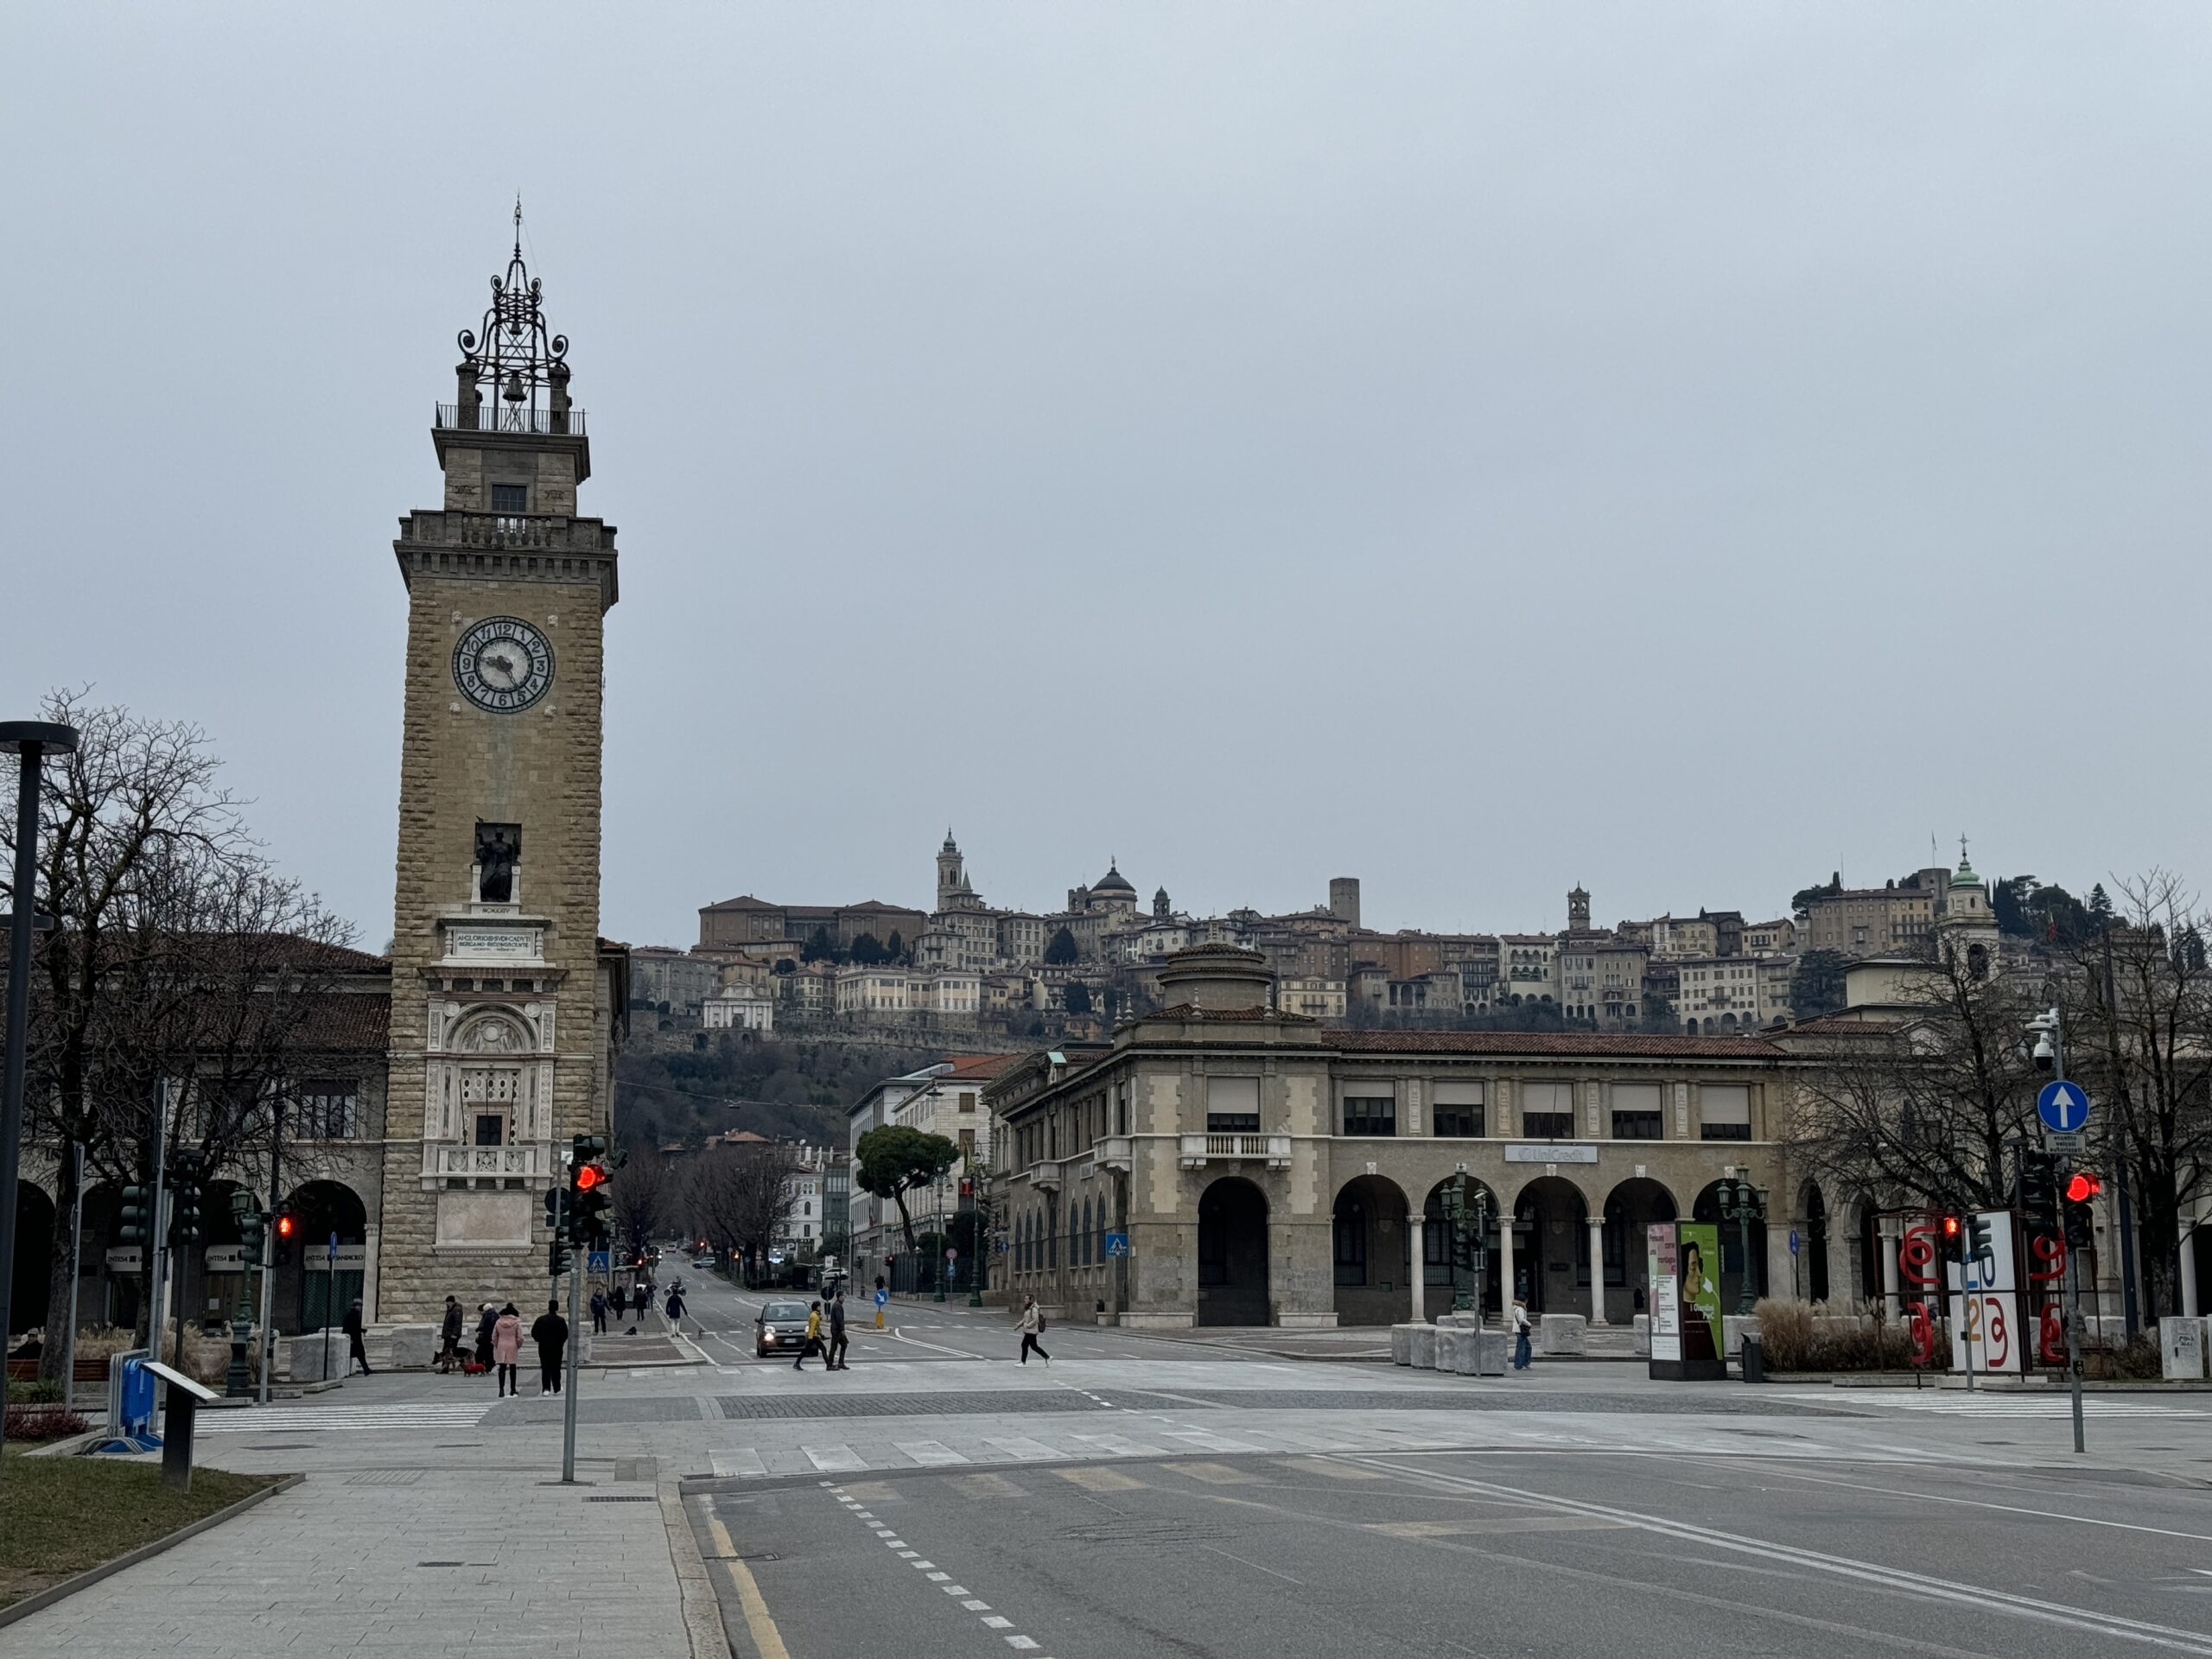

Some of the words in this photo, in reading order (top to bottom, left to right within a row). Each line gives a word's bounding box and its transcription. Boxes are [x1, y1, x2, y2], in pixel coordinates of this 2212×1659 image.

[480, 627, 491, 639] 11
[498, 624, 512, 637] 12
[519, 628, 525, 641] 1
[467, 640, 479, 652] 10
[531, 640, 541, 653] 2
[462, 658, 471, 670] 9
[537, 660, 545, 672] 3
[467, 676, 475, 688] 8
[531, 678, 539, 690] 4
[480, 689, 489, 701] 7
[499, 695, 506, 706] 6
[518, 690, 526, 702] 5
[1533, 1147, 1586, 1160] UniCredit
